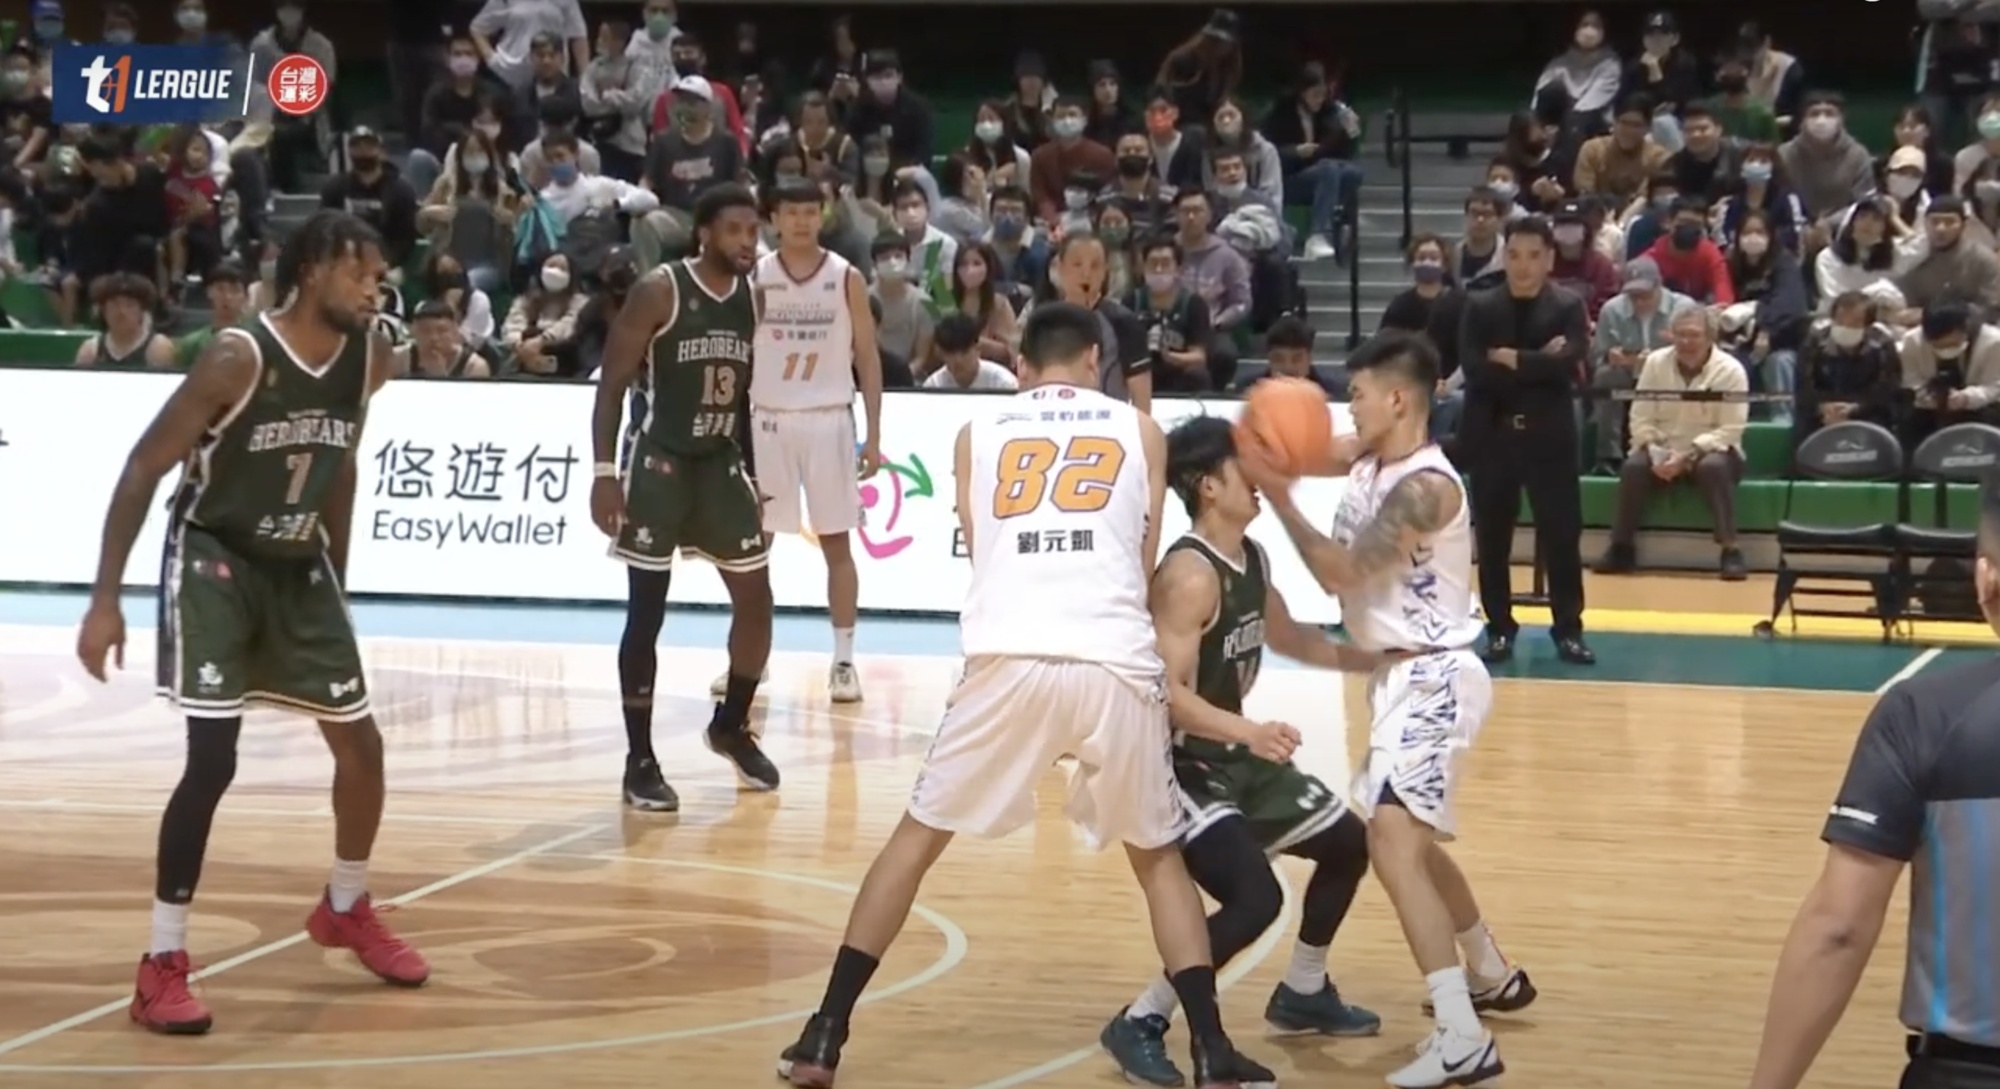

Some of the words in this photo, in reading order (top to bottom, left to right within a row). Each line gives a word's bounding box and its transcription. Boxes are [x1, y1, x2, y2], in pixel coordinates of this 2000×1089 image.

[701, 365, 737, 406] 13
[782, 352, 819, 382] 11
[286, 452, 314, 505] 7
[374, 439, 580, 503] 悠遊付
[993, 435, 1126, 520] 82
[372, 509, 568, 550] EasyWallet
